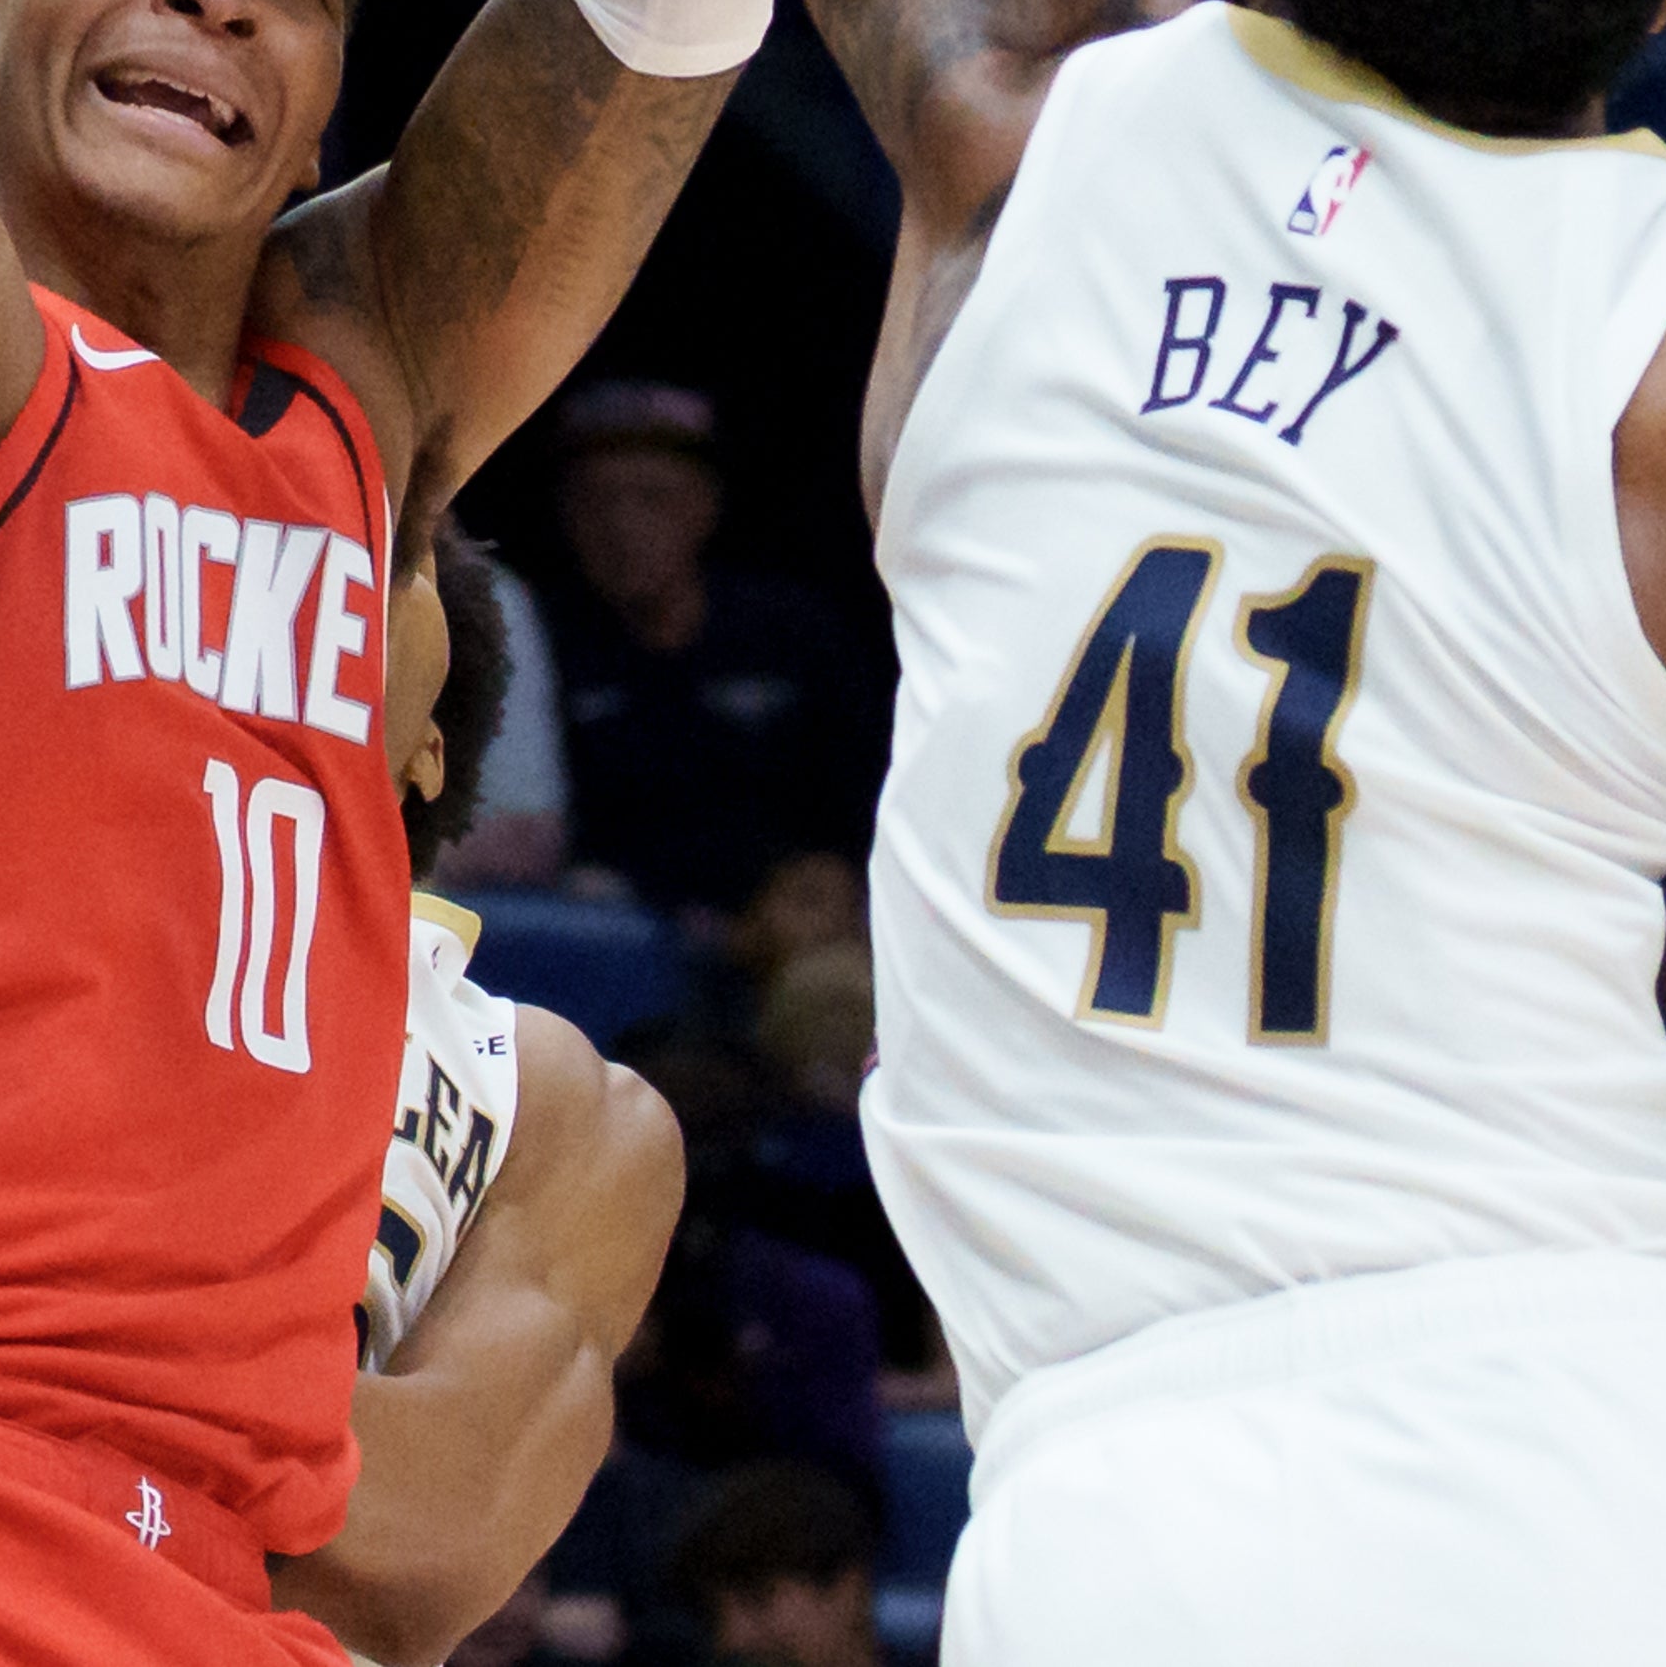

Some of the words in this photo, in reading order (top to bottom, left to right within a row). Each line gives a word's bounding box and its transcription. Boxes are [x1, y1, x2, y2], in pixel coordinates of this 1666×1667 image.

[1140, 275, 1400, 446] BEY
[64, 490, 375, 747] ROCKE
[202, 756, 326, 1075] 10
[984, 534, 1377, 1047] 41
